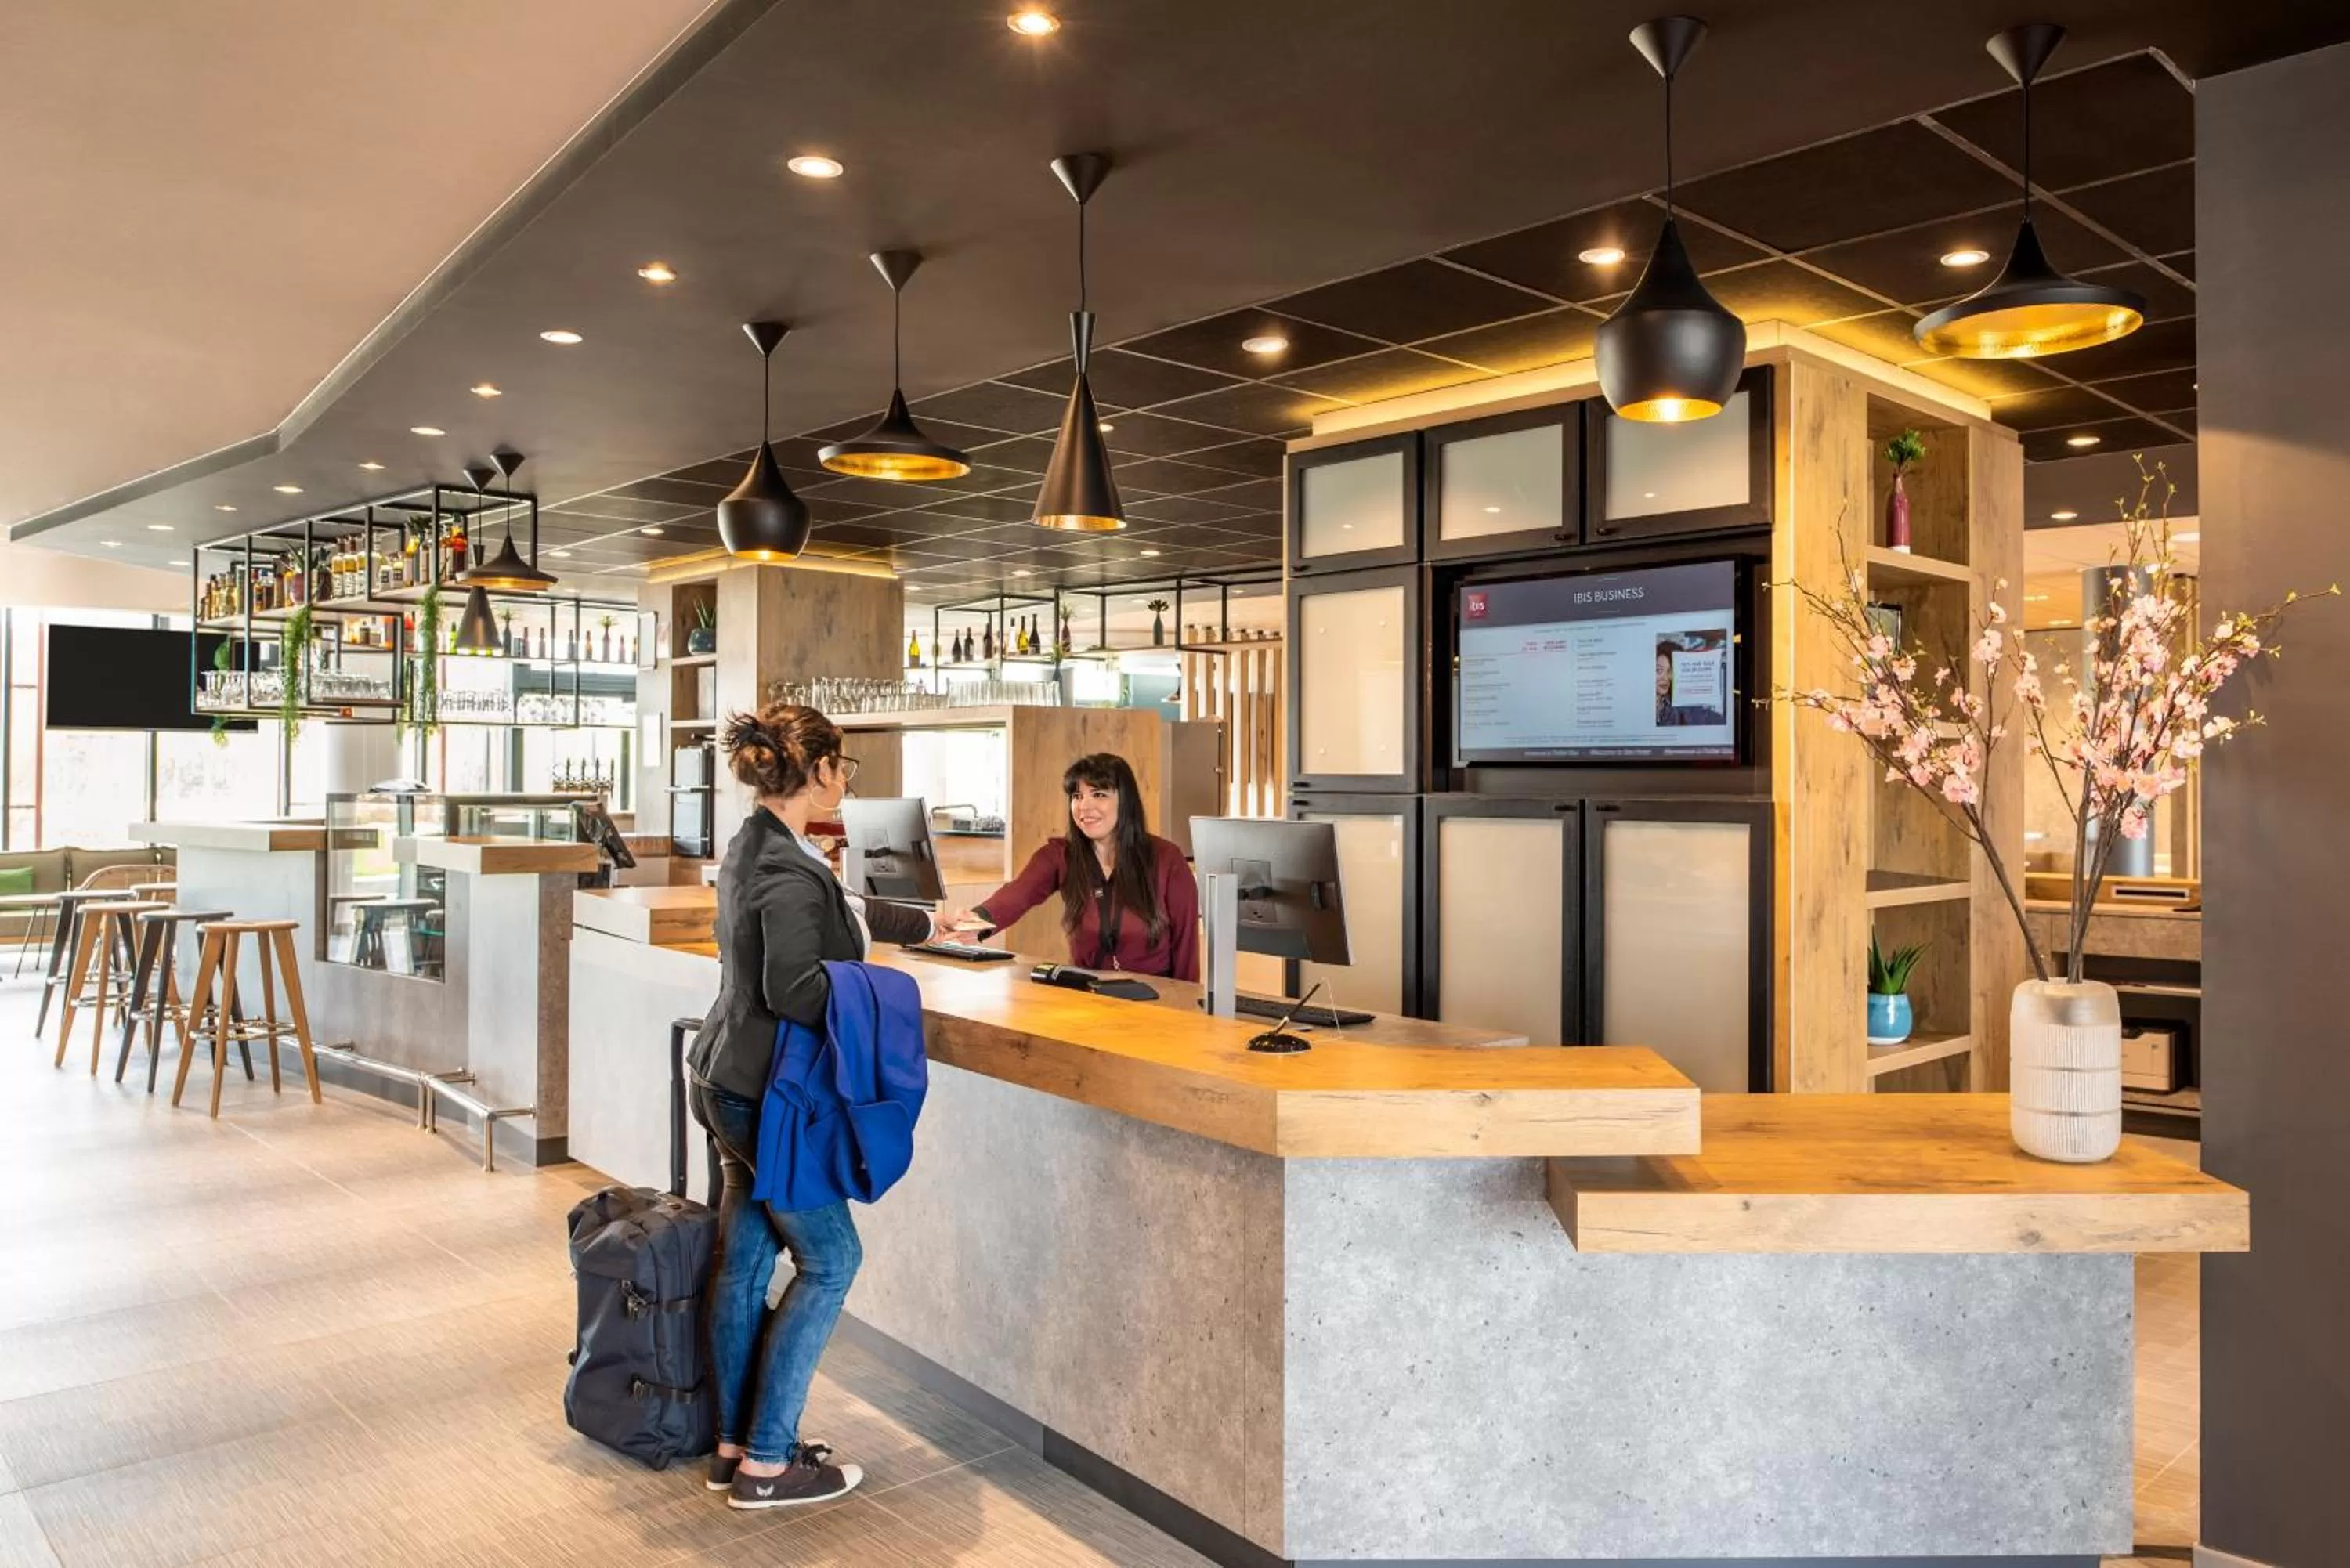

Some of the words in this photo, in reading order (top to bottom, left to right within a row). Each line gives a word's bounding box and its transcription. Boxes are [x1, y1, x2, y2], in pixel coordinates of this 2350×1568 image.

[1573, 591, 1593, 603] IBIS
[1594, 587, 1644, 602] BUSINESS
[1469, 601, 1484, 611] ibis
